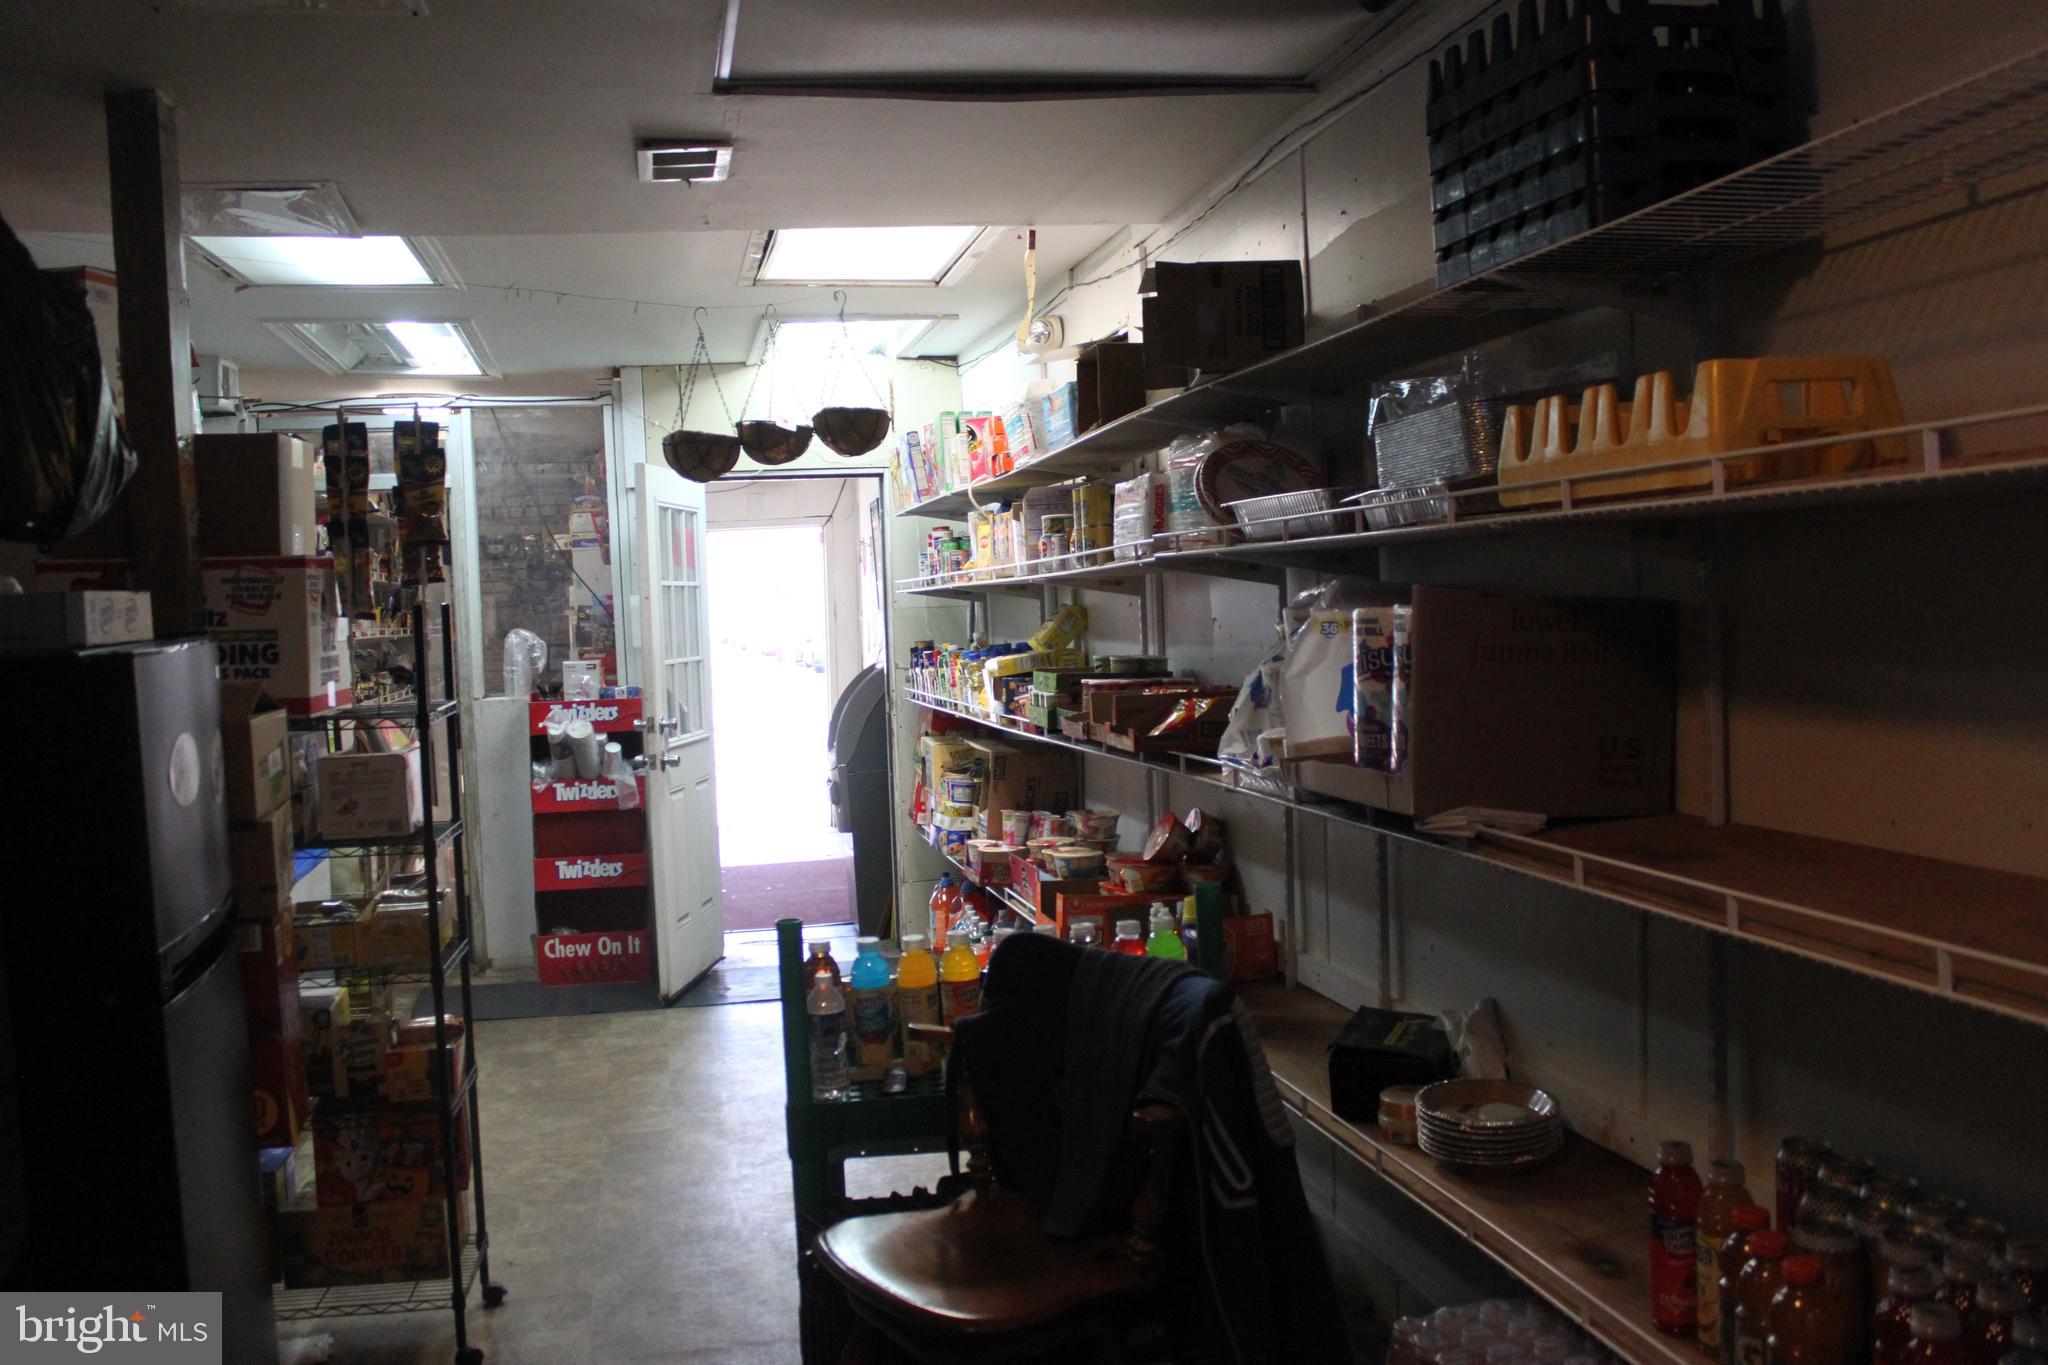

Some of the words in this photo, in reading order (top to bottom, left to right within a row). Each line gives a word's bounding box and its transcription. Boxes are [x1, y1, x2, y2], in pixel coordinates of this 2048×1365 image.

[1321, 621, 1340, 636] 36
[234, 667, 271, 679] PACK
[555, 858, 624, 879] Twizzlers
[544, 938, 592, 959] Chew
[597, 936, 622, 956] On
[627, 935, 641, 954] It
